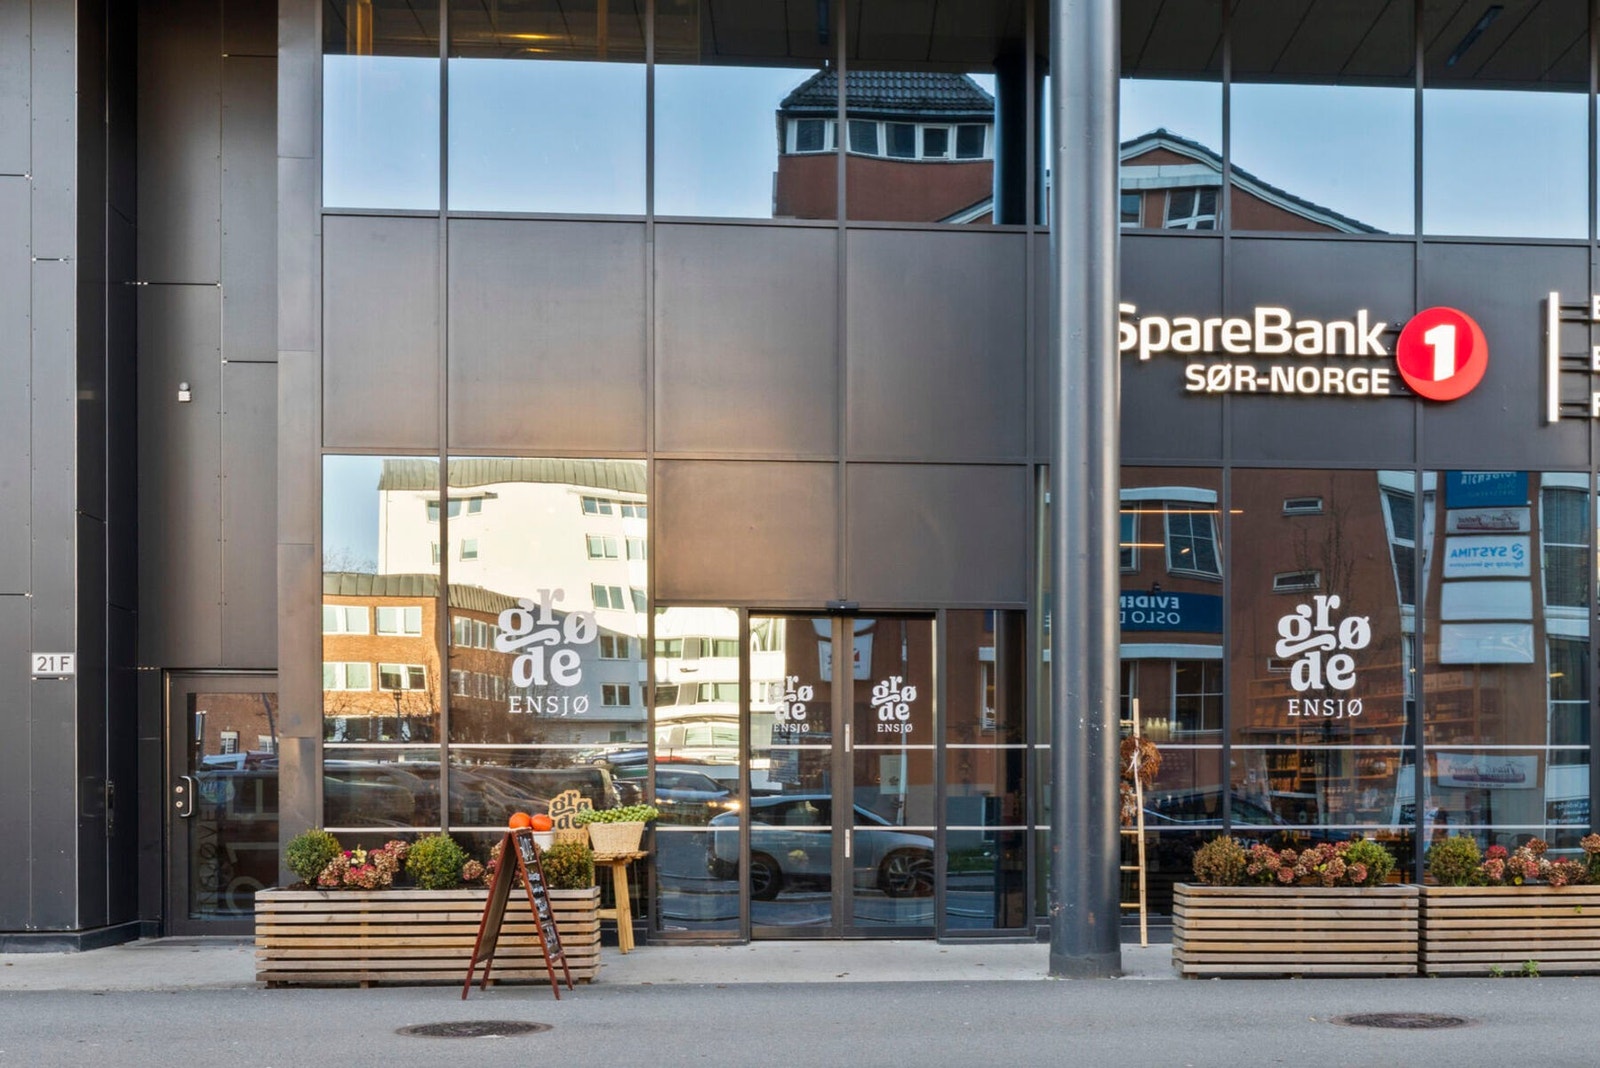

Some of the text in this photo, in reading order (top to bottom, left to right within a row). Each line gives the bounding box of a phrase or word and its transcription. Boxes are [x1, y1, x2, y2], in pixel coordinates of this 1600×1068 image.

[1118, 304, 1455, 382] SpareBank 1
[1185, 364, 1390, 395] SØR-NORGE
[508, 694, 590, 716] ENSJØ
[1287, 698, 1363, 719] ENSJØ
[774, 723, 810, 735] ENSJØ
[877, 723, 913, 735] ENSJØ
